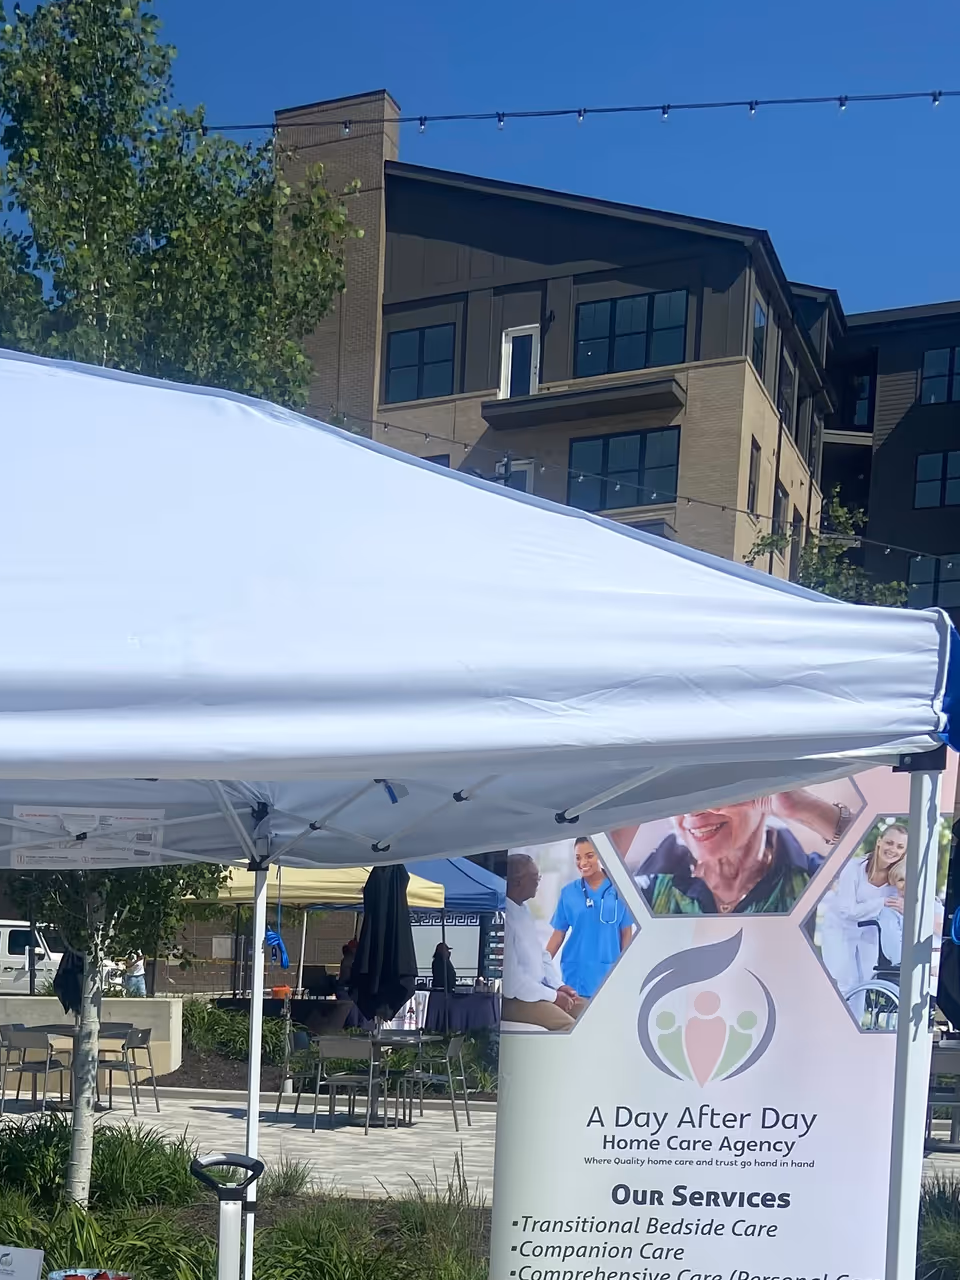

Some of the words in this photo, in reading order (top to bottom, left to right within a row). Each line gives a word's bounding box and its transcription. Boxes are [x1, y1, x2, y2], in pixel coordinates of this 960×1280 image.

[586, 1106, 605, 1127] A
[615, 1106, 668, 1136] Day
[677, 1104, 751, 1128] After
[761, 1107, 817, 1138] Day
[603, 1135, 660, 1150] Home
[667, 1135, 712, 1151] Care
[718, 1136, 796, 1158] Agency
[613, 1157, 645, 1167] Quality
[647, 1157, 672, 1165] home
[695, 1158, 713, 1166] and
[740, 1161, 752, 1169] go
[754, 1159, 778, 1167] hand
[791, 1160, 815, 1168] hand
[521, 1216, 640, 1233] Transitional
[646, 1217, 725, 1236] Bedside
[732, 1219, 778, 1237] Care
[520, 1241, 632, 1262] Companion
[640, 1243, 684, 1260] Care
